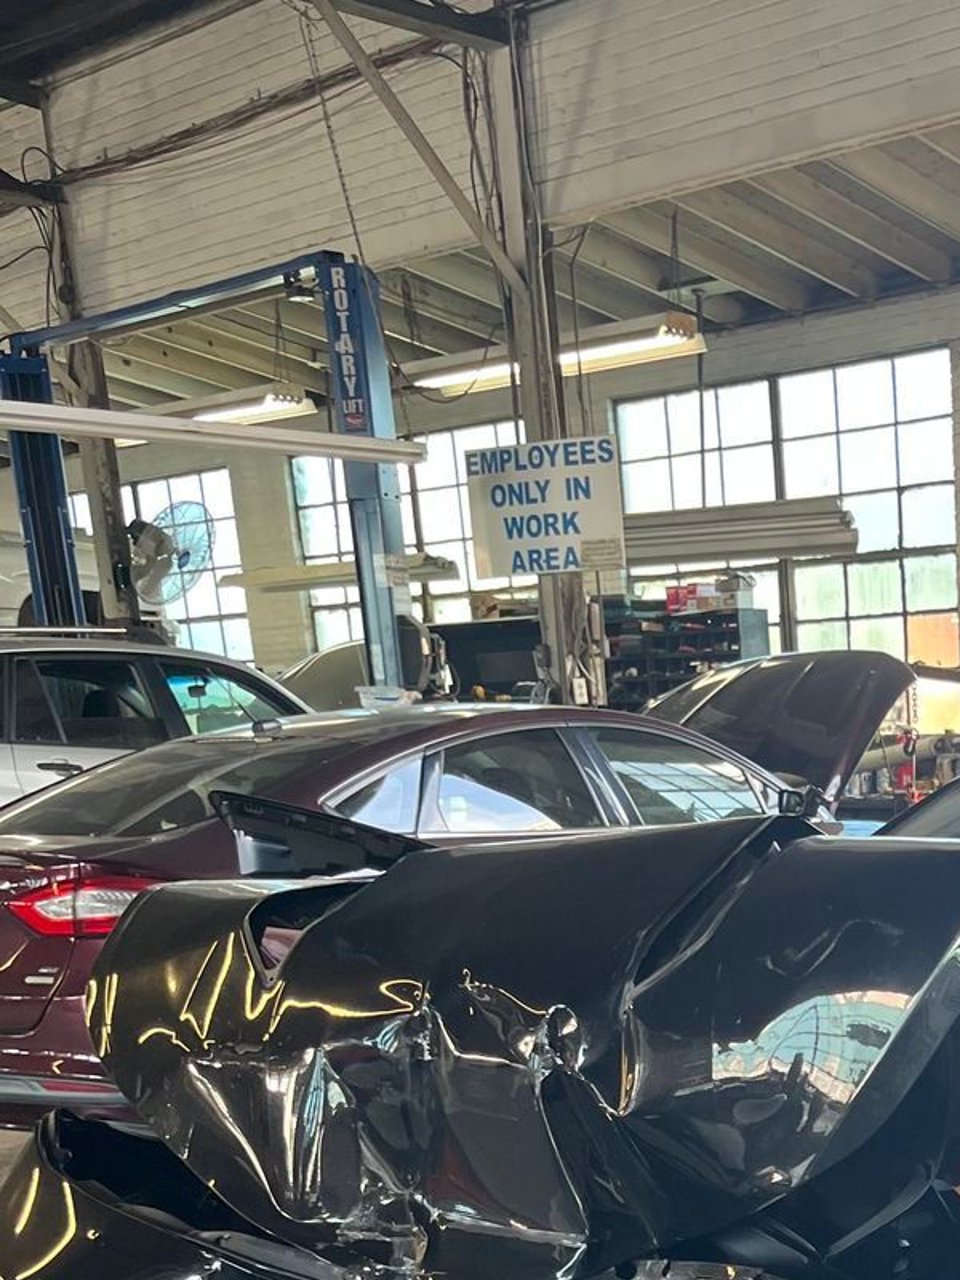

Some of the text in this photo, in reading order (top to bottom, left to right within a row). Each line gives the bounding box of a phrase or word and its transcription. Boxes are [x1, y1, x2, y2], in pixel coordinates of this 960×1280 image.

[331, 266, 356, 397] ROTARY
[465, 439, 614, 476] EMPLOYEES
[490, 475, 591, 507] ONLY IN
[503, 511, 581, 540] WORK
[512, 546, 580, 573] AREA
